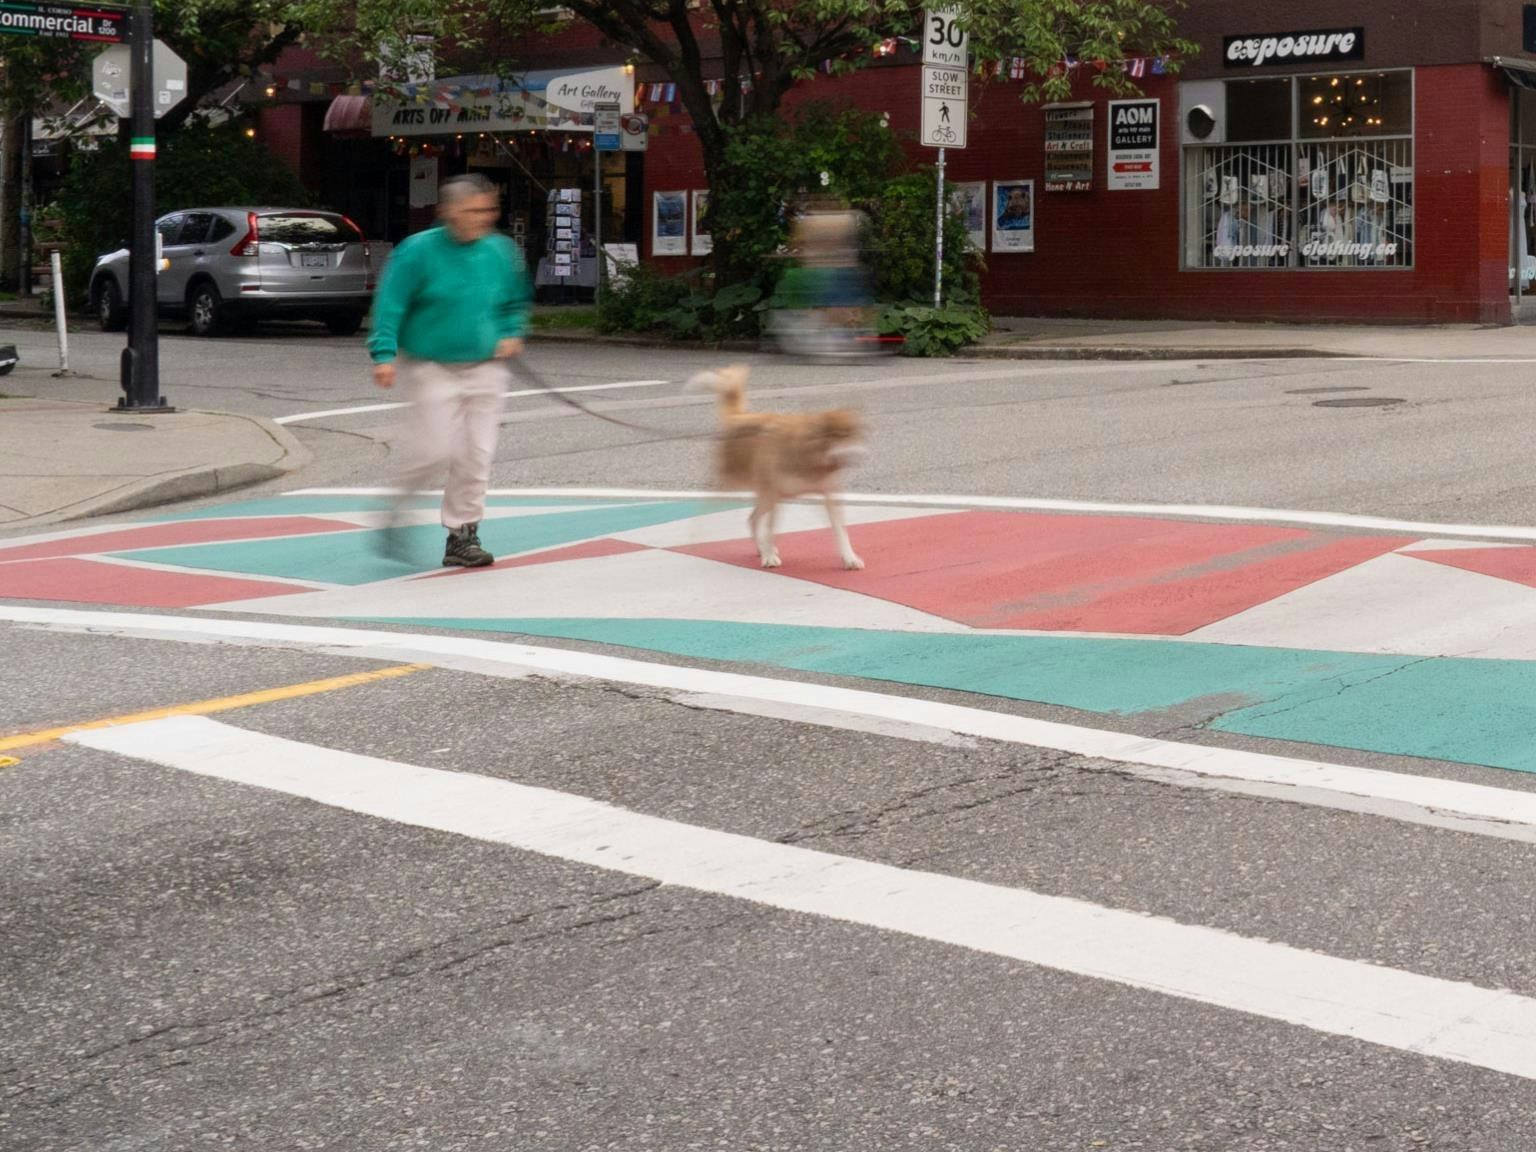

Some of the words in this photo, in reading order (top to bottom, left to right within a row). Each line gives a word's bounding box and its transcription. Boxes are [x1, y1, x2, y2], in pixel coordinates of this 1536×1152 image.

[0, 11, 93, 33] ommercial
[102, 19, 112, 27] Dr
[98, 27, 116, 36] 1200
[929, 16, 963, 48] 30
[932, 49, 960, 62] km/h
[1227, 32, 1356, 66] exposure
[932, 71, 959, 83] SLOW
[558, 84, 577, 97] Art
[580, 85, 621, 102] Gallery
[929, 83, 961, 96] STREET
[393, 108, 425, 125] ARTS
[430, 108, 451, 124] OFF
[1115, 107, 1153, 125] AOM
[1046, 141, 1059, 150] Art
[1070, 140, 1088, 149] Craft
[1115, 135, 1152, 144] GALLERY
[1075, 181, 1090, 190] Art
[1213, 243, 1290, 261] exposure
[1302, 240, 1398, 260] clothing.ca
